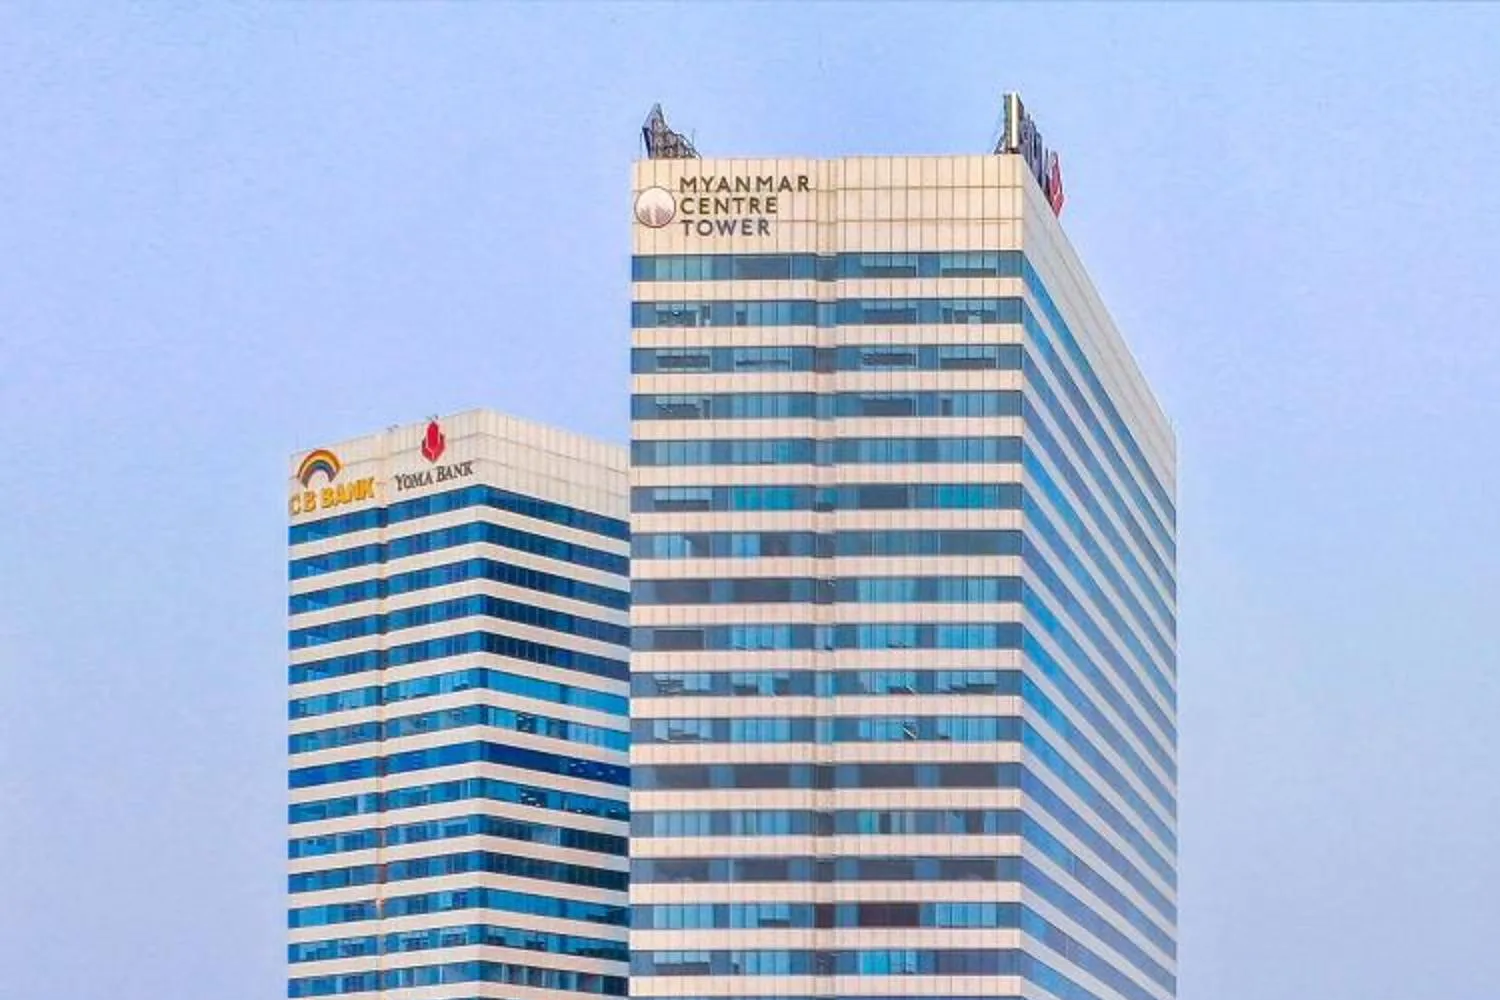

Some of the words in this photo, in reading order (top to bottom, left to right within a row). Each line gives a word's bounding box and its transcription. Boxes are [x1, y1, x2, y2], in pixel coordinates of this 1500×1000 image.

[680, 175, 810, 193] MYANMAR
[679, 196, 778, 215] CENTRE
[680, 218, 771, 237] TOWER
[394, 470, 434, 491] YOMA
[436, 461, 473, 483] BANK
[321, 477, 376, 509] BANK
